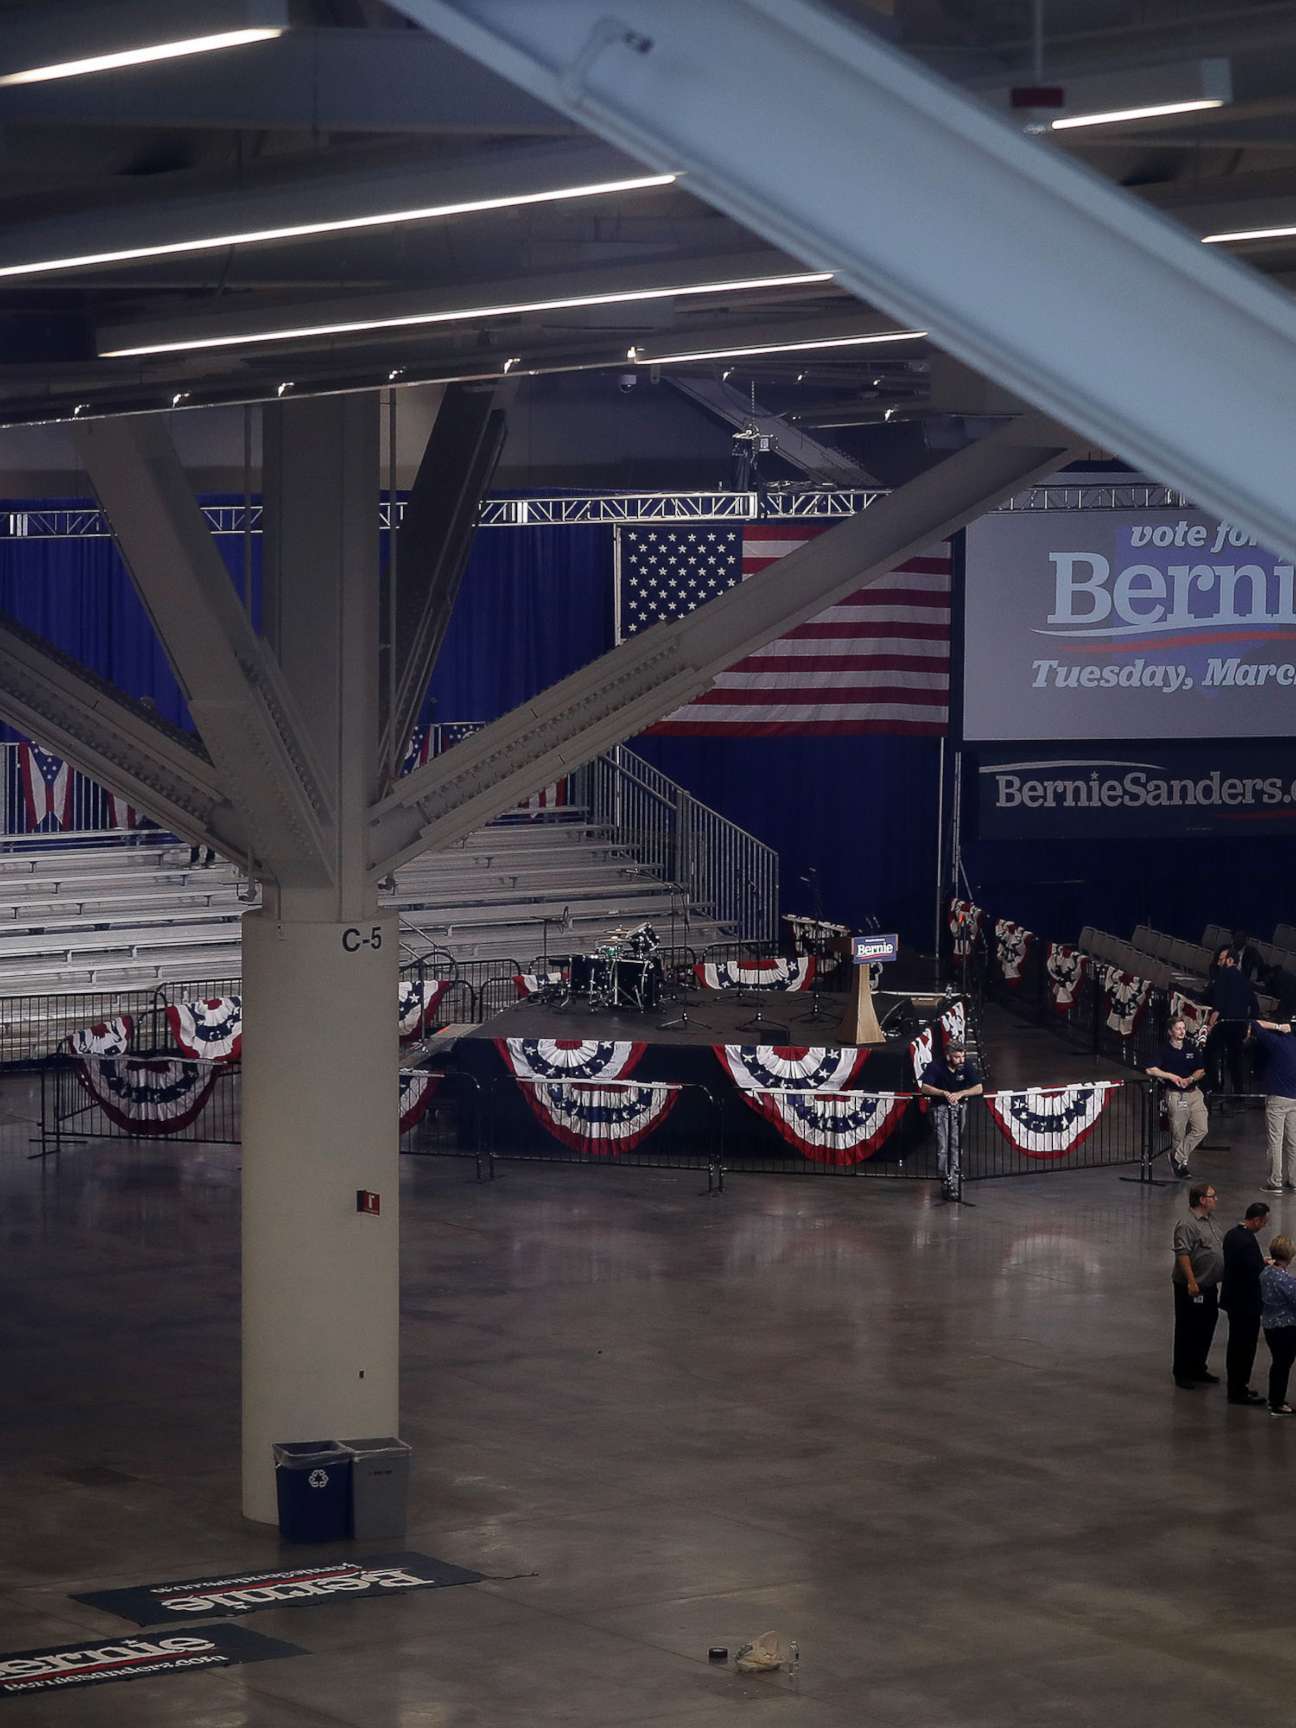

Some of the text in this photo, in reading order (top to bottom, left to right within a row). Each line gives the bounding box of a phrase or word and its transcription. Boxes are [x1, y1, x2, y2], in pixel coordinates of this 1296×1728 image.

[1130, 520, 1207, 547] vote
[1032, 658, 1194, 693] Tuesday,
[342, 926, 382, 952] C-5
[857, 942, 894, 956] Bernie
[161, 1568, 435, 1611] Bernie
[0, 1637, 216, 1677] ernie
